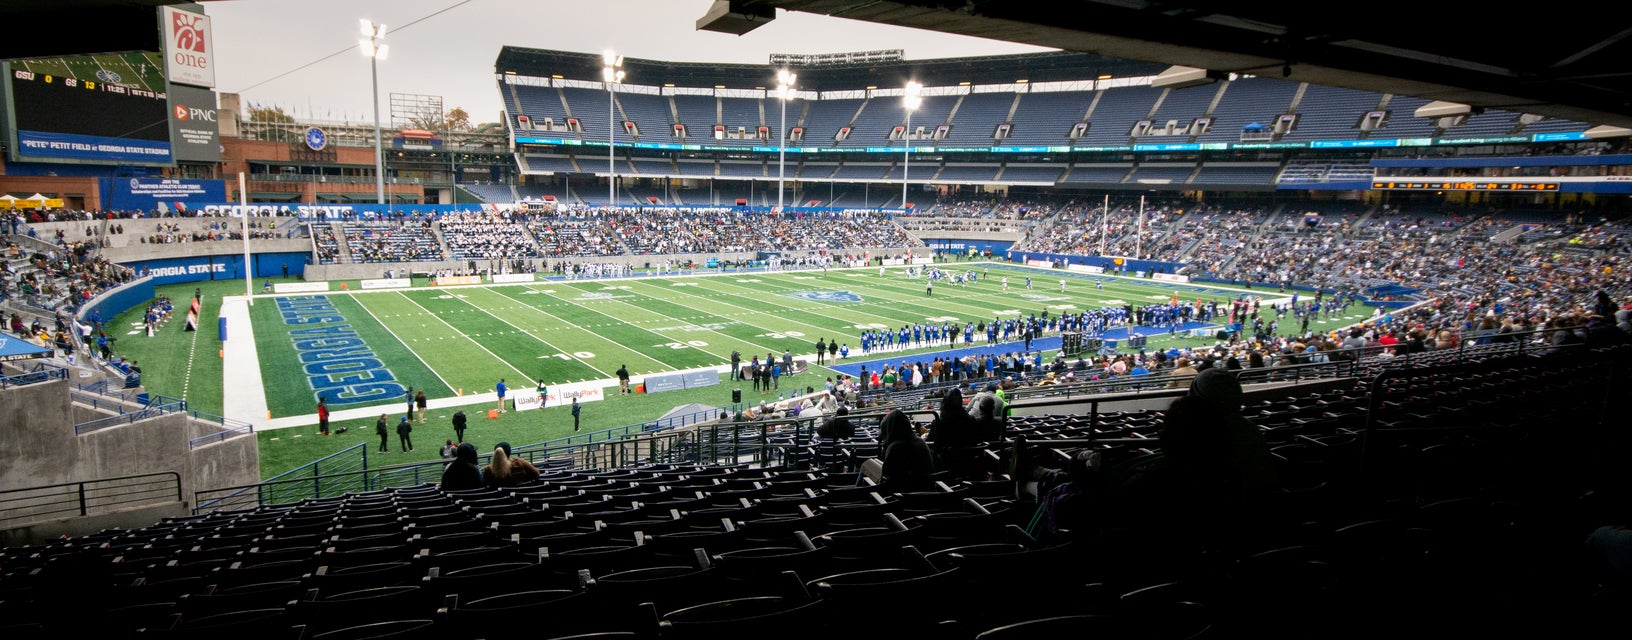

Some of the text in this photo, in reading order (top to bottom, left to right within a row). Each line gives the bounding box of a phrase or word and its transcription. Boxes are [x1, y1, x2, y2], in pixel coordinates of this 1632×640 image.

[175, 52, 207, 69] one
[15, 70, 35, 80] GSU
[44, 74, 53, 84] 0
[65, 78, 77, 87] GS
[84, 81, 95, 90] 13
[188, 107, 217, 122] PNC
[50, 141, 70, 150] PETIT
[71, 143, 91, 151] FIELD
[98, 145, 126, 153] GEORGIA
[125, 146, 144, 154] STATE
[298, 205, 353, 219] STATE
[141, 263, 226, 278] ORGIA STATE
[274, 294, 348, 326] STATE
[664, 340, 709, 350] 20
[552, 351, 596, 361] 10
[287, 323, 408, 406] GEORGIA
[518, 393, 556, 405] WallyPrk
[563, 387, 599, 398] WallyPark
